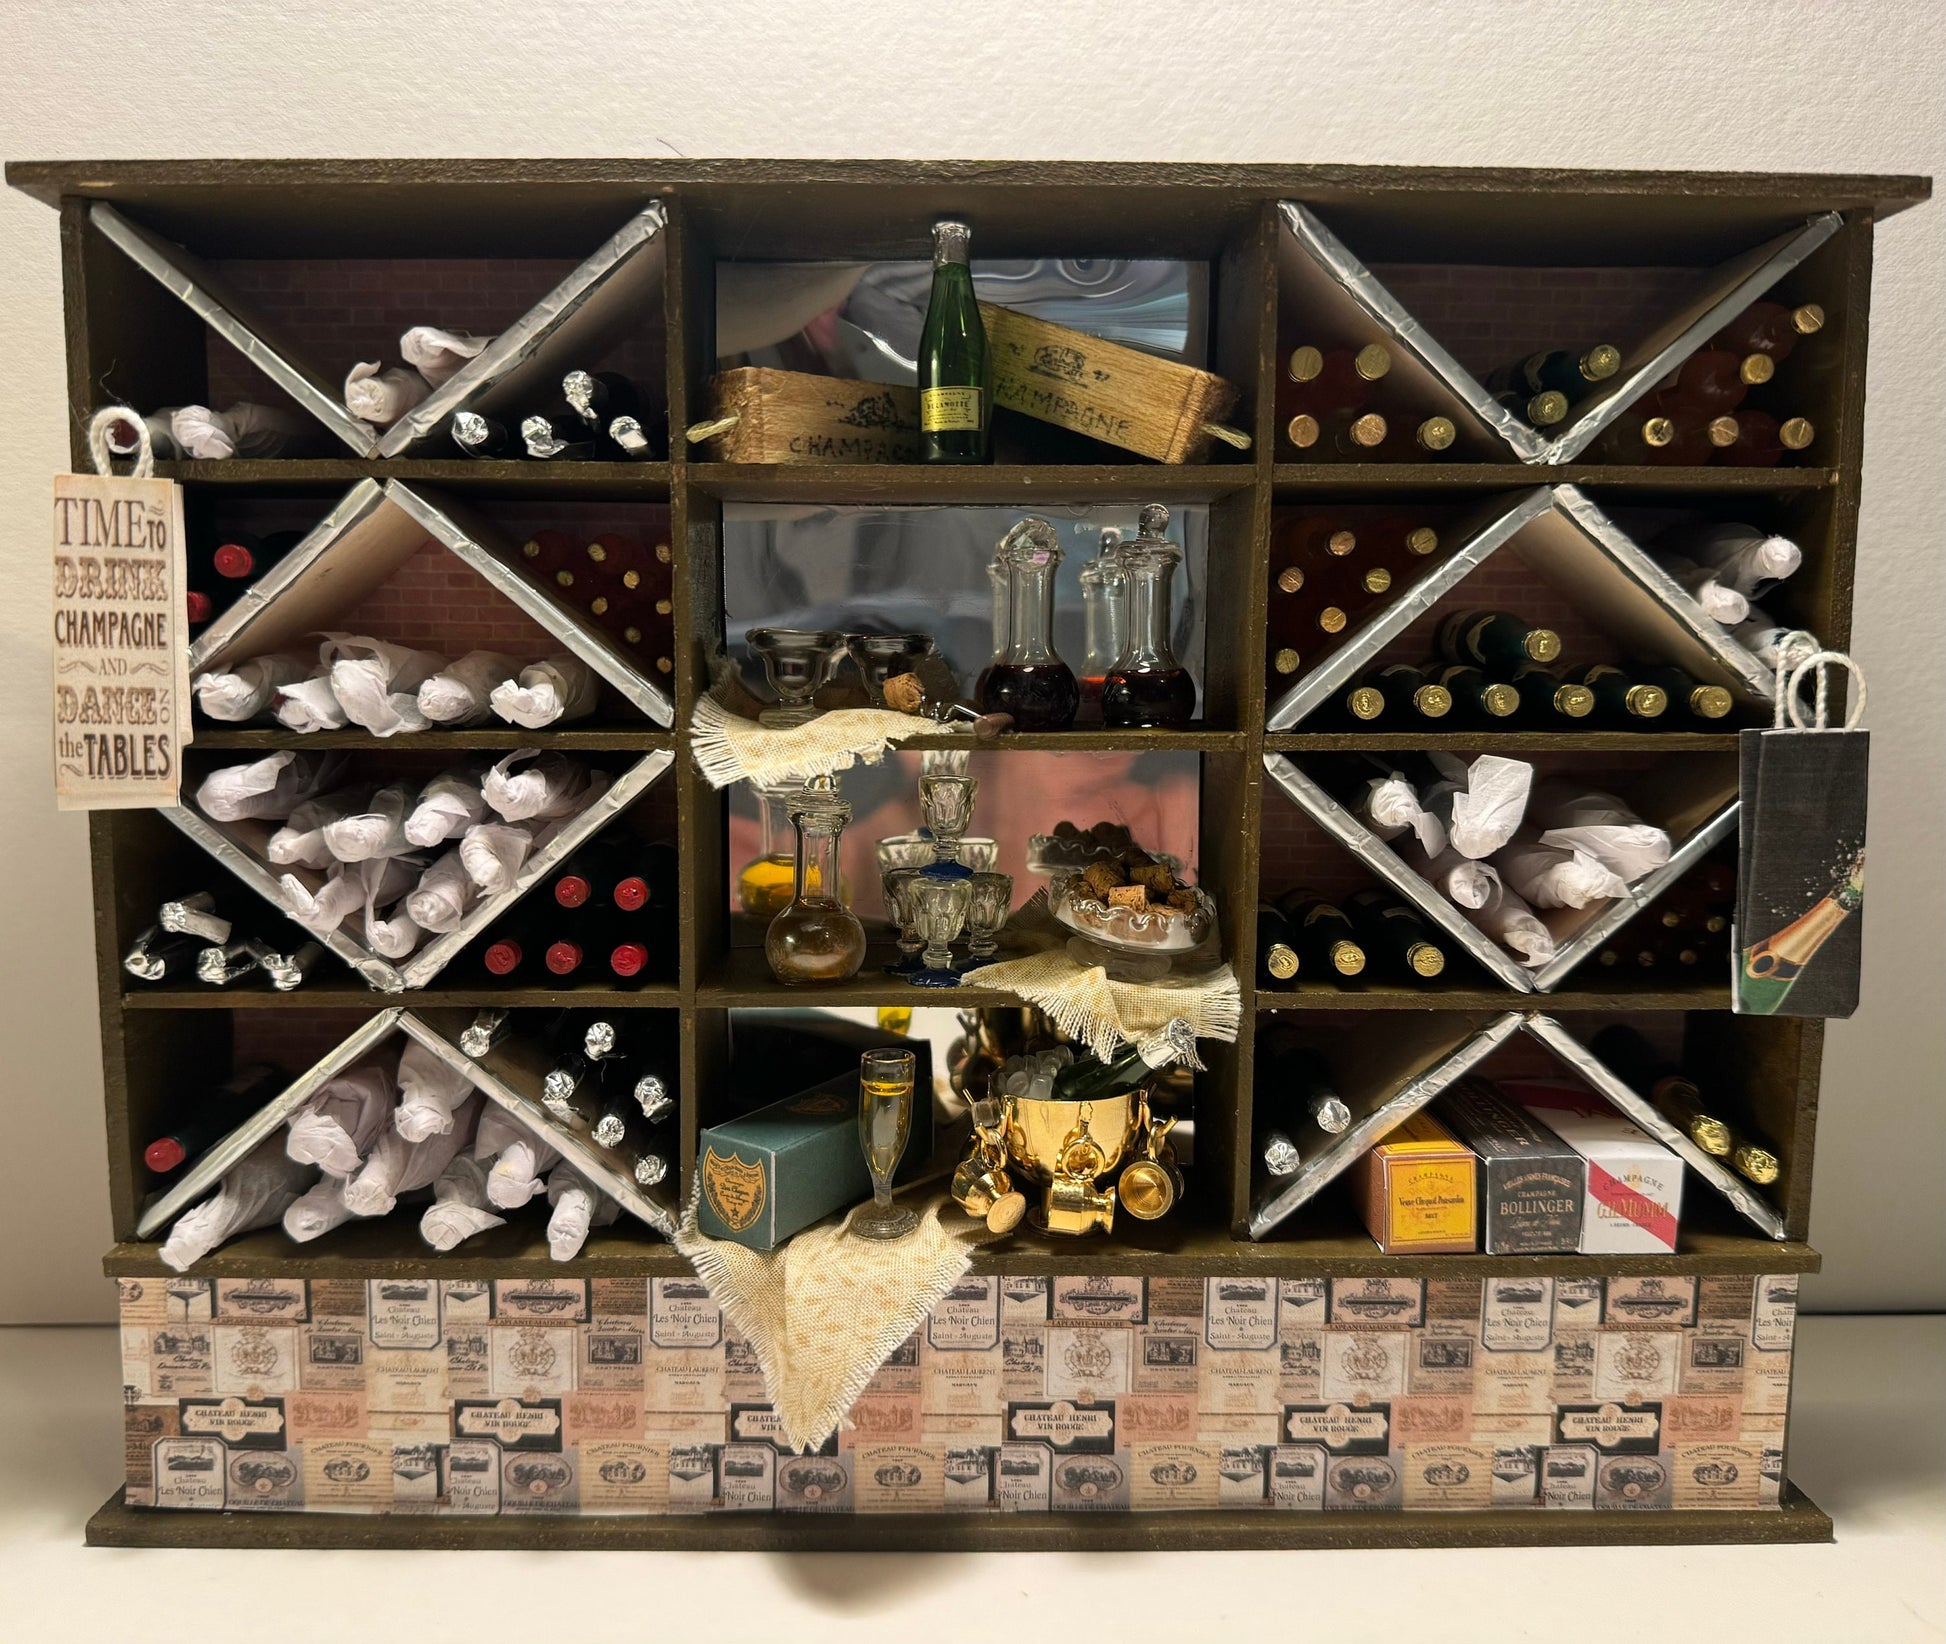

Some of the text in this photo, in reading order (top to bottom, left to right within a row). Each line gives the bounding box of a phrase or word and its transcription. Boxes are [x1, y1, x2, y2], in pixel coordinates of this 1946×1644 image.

[789, 434, 914, 460] CHAMPAG
[54, 497, 167, 551] TIME TO
[54, 556, 168, 601] DRINK
[54, 609, 167, 651] CHAMPAGNE
[98, 658, 128, 676] AND
[57, 685, 158, 725] DANCE
[58, 731, 172, 780] the TABLES
[1602, 1174, 1665, 1192] CHAMPAGNE
[1500, 1199, 1575, 1216] BOLLINGER
[669, 1304, 702, 1312] Chateau
[947, 1305, 979, 1314] Chateau
[1224, 1306, 1257, 1314] Chateau
[653, 1314, 718, 1324] Les Noir Chien
[931, 1316, 995, 1326] Les Noir Chien
[1209, 1316, 1273, 1326] Les Noir Chien
[656, 1366, 689, 1374] CHATEAU
[690, 1366, 719, 1374] LAURENT
[471, 1412, 511, 1420] CHATEAU
[1300, 1416, 1338, 1424] CHATEAU
[1572, 1416, 1612, 1424] CHATEAU
[586, 1442, 660, 1457] CHATEAU FOURNIER
[862, 1446, 895, 1459] CHATEAU
[1138, 1444, 1172, 1458] CHATEAU
[159, 1487, 223, 1496] Les Noir Chien
[452, 1486, 498, 1496] Noir Chien
[1000, 1490, 1047, 1500] Noir Chien
[726, 1492, 772, 1502] Noir Chien
[1275, 1492, 1320, 1501] Noir Chien
[1547, 1492, 1591, 1502] Noir Chien
